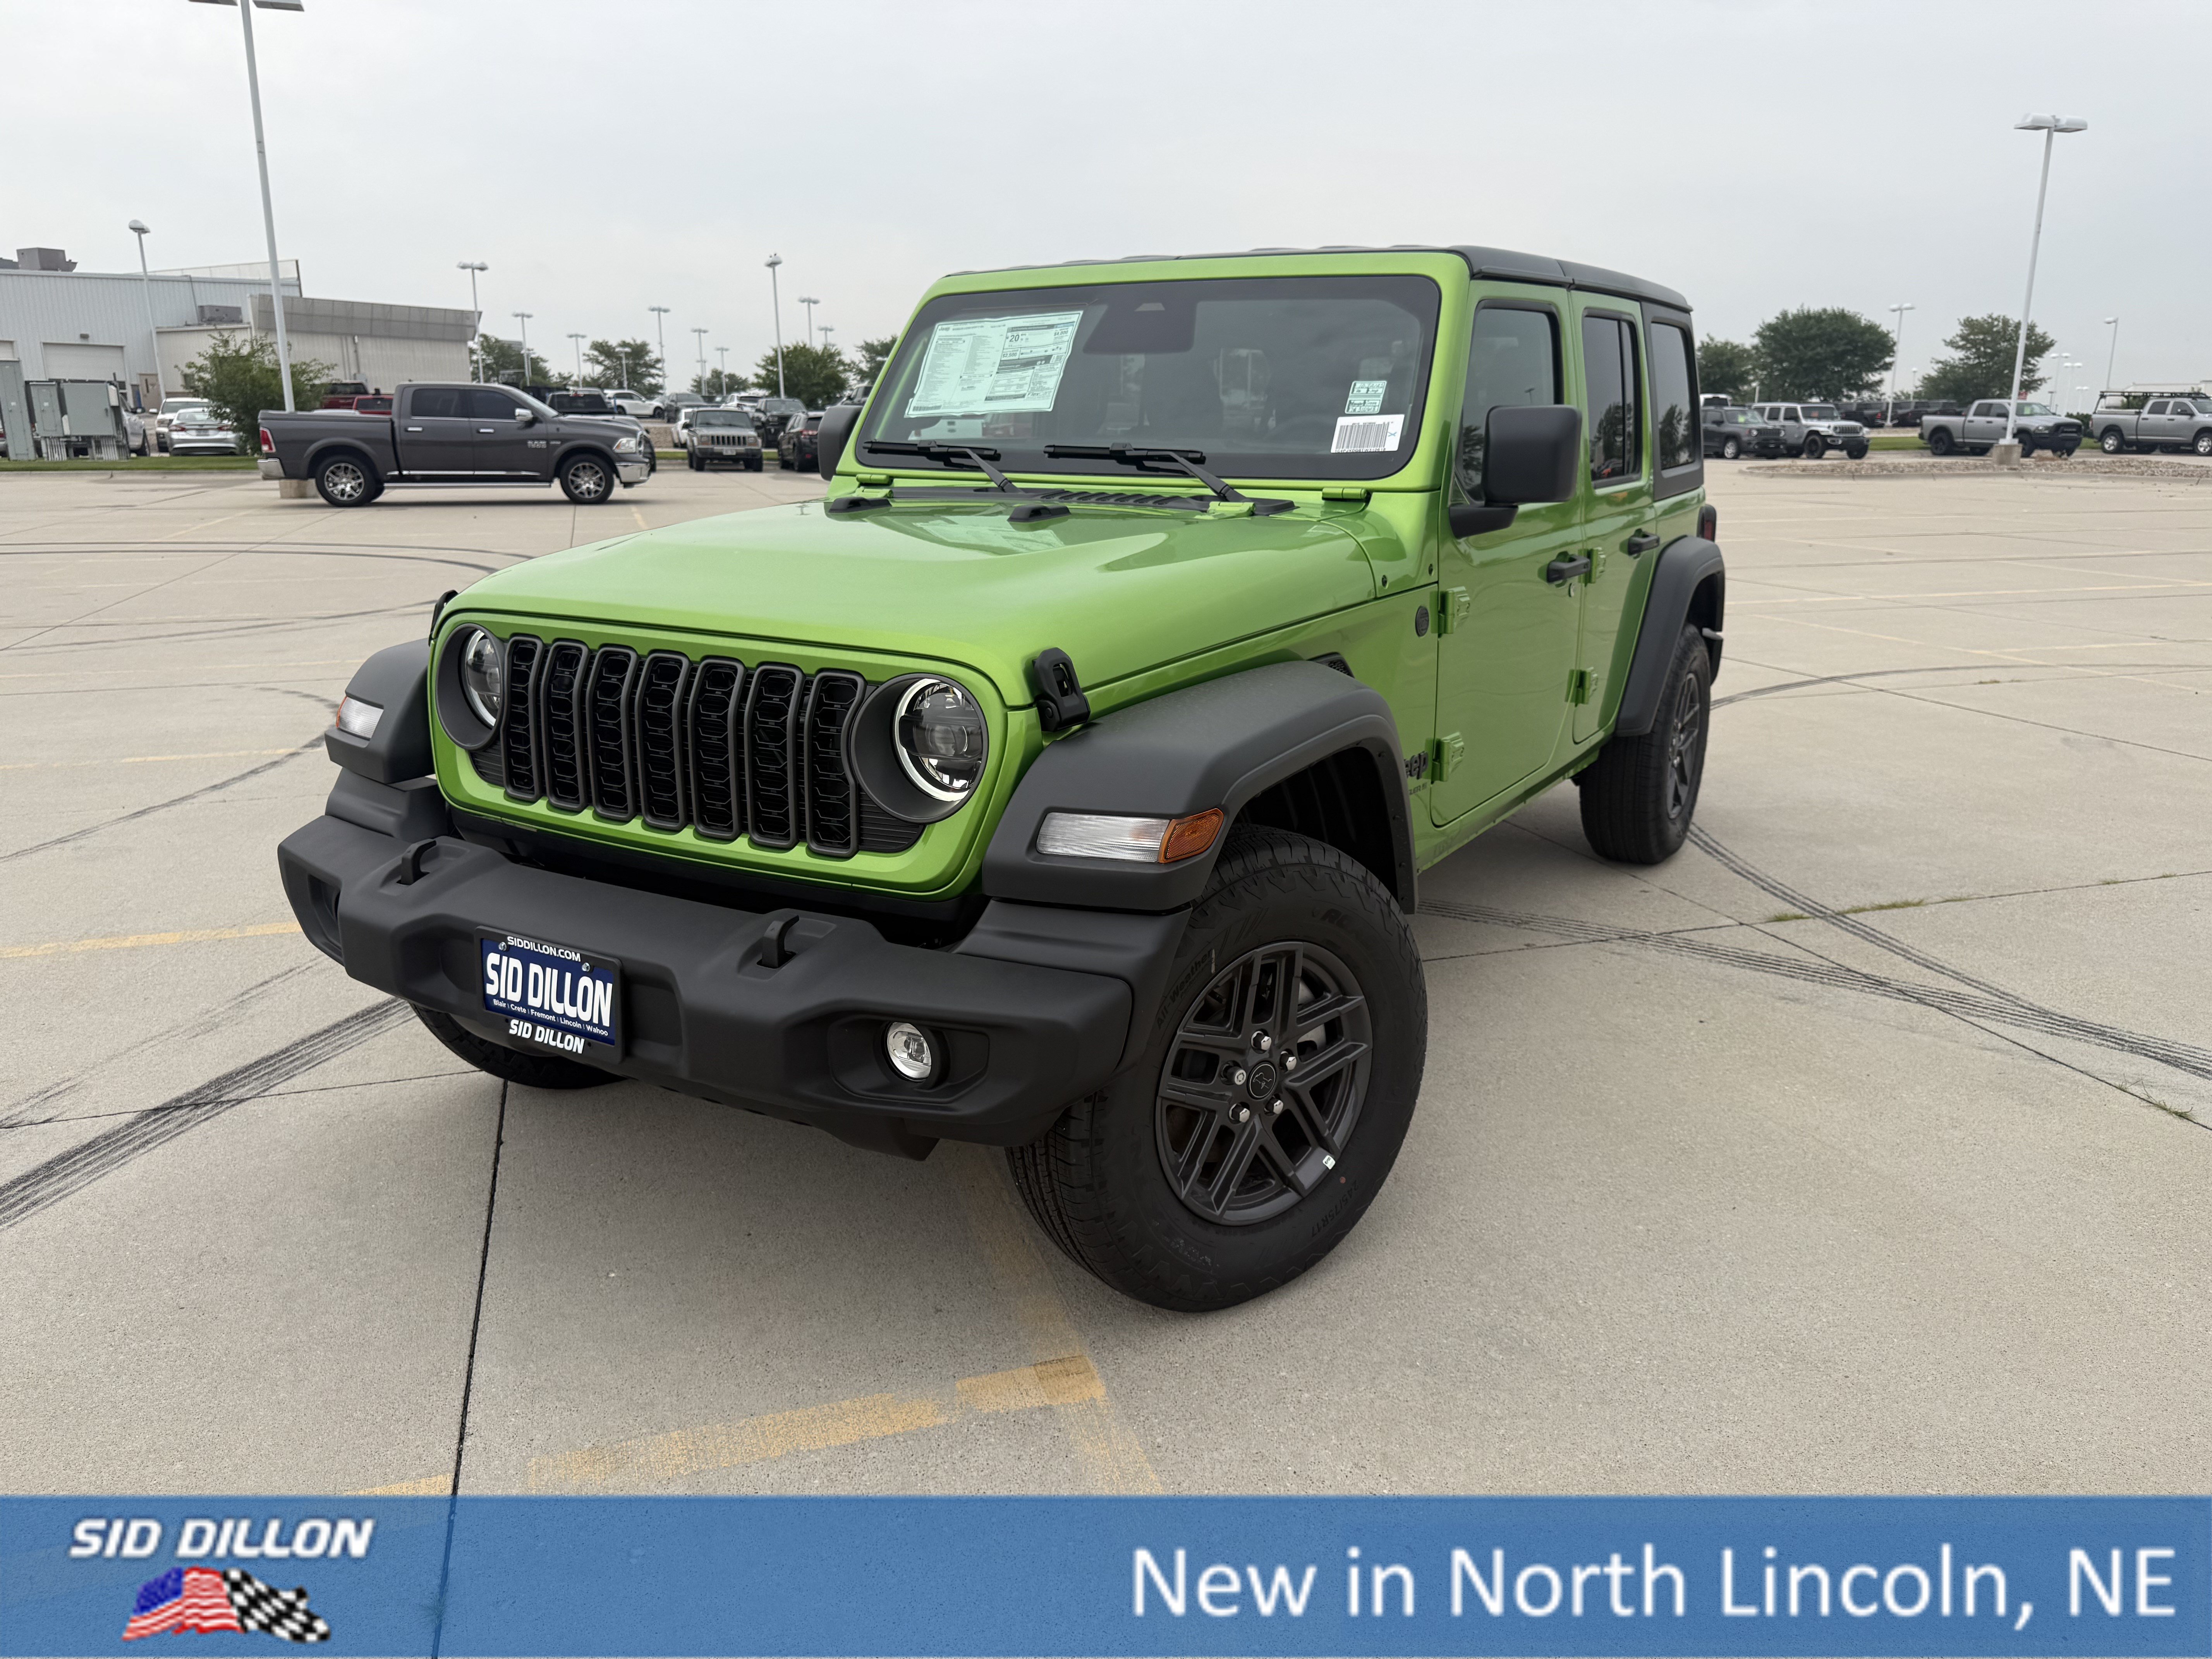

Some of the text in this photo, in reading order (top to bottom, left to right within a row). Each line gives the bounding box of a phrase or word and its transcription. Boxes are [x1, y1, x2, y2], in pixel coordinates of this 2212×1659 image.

[1009, 334, 1020, 342] 20
[1404, 750, 1429, 780] eep
[507, 936, 581, 962] SIDDILLON.COM
[486, 953, 613, 1027] SID DILLON
[1156, 949, 1212, 1030] All-Weather
[493, 999, 608, 1036] Blair Crete Fremont Lincoln Wahoo
[509, 1019, 585, 1054] SID DILLON
[1311, 1179, 1359, 1237] 245/75R17
